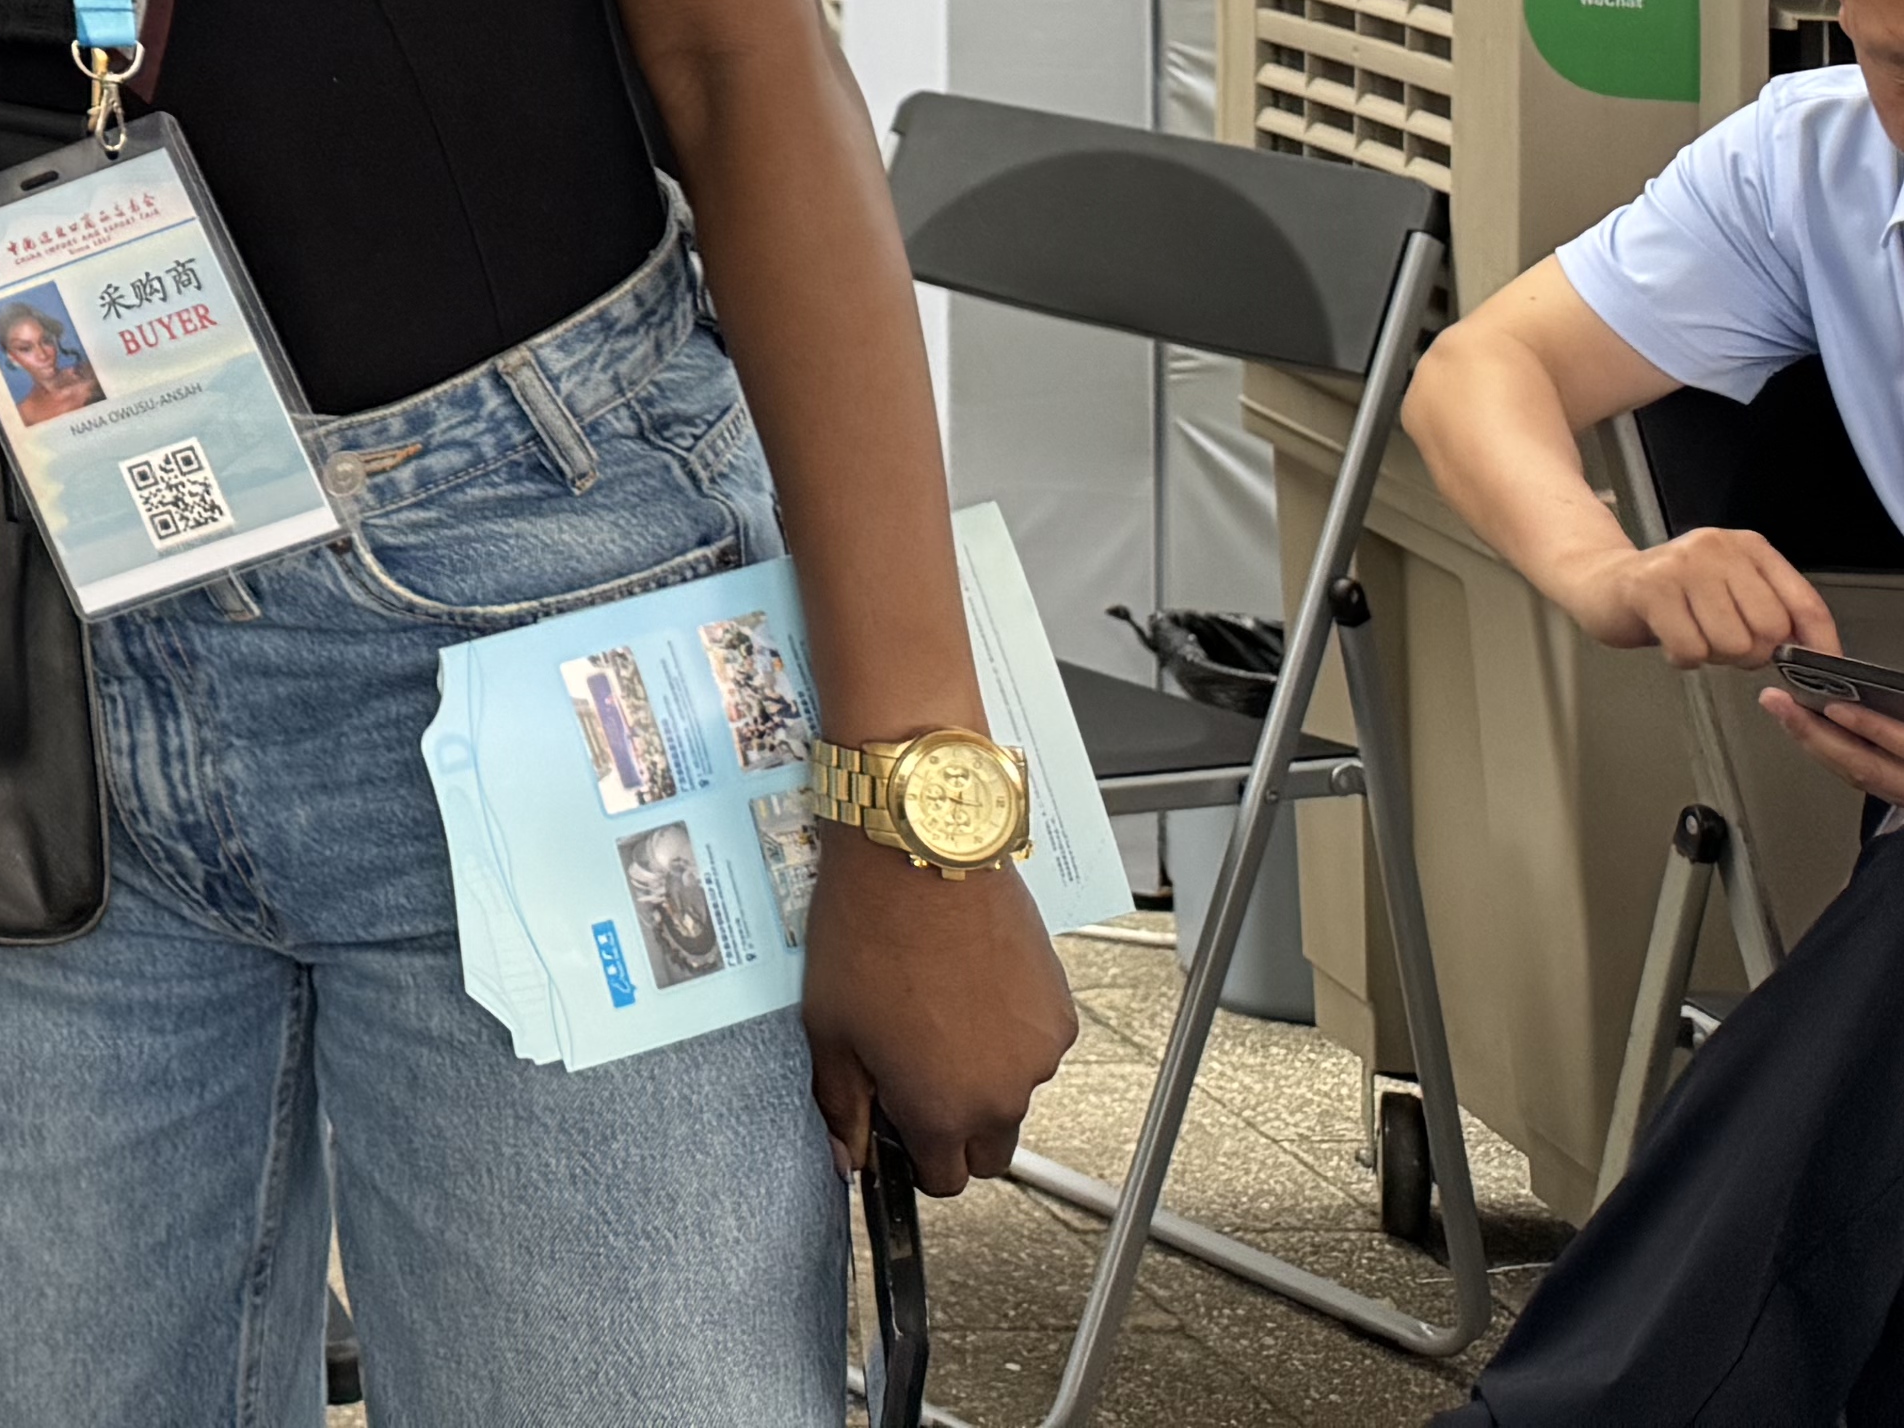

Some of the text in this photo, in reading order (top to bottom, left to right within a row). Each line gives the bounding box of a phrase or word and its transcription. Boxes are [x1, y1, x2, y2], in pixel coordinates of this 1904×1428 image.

[98, 257, 202, 320] 采购商
[118, 303, 219, 356] BUYER
[70, 383, 203, 437] NANA OWUSU-ANSAH
